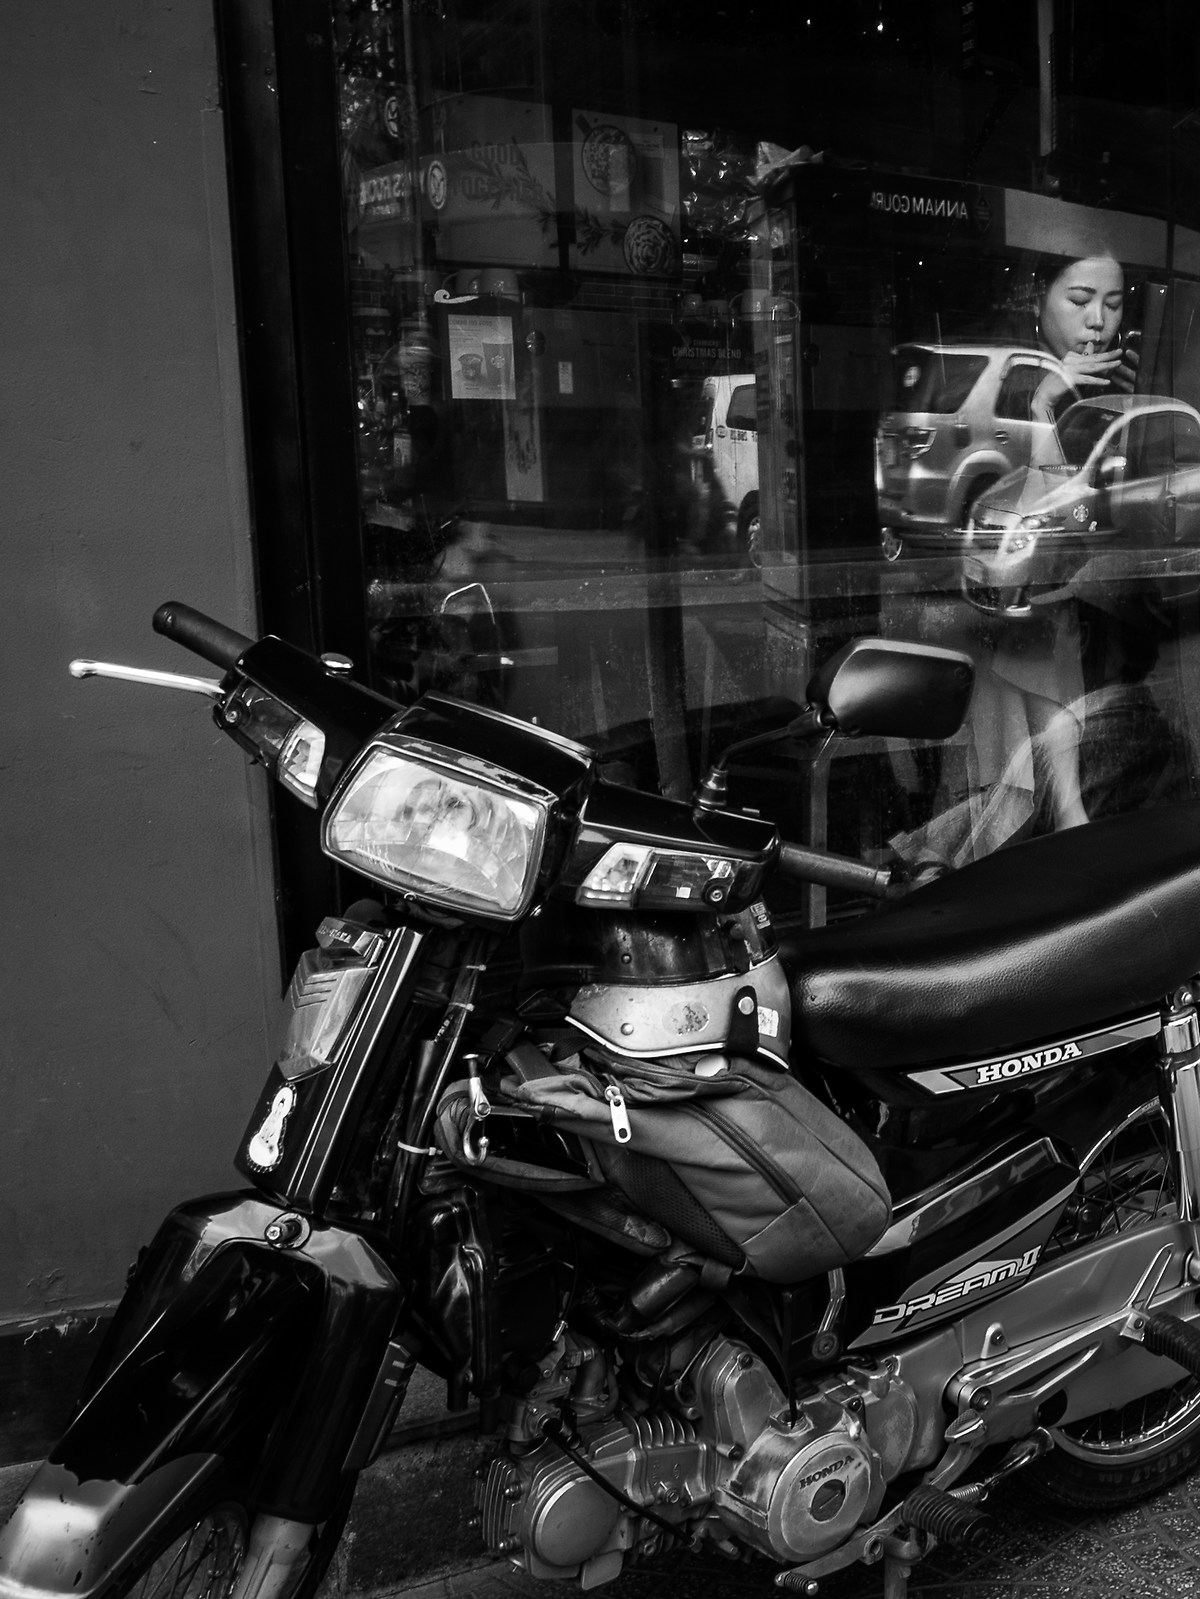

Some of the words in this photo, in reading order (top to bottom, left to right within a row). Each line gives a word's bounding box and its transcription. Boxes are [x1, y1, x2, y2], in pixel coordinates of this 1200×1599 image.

[976, 1042, 1083, 1084] HONDA
[872, 1261, 1019, 1325] DREAM
[799, 1455, 855, 1490] HONDA
